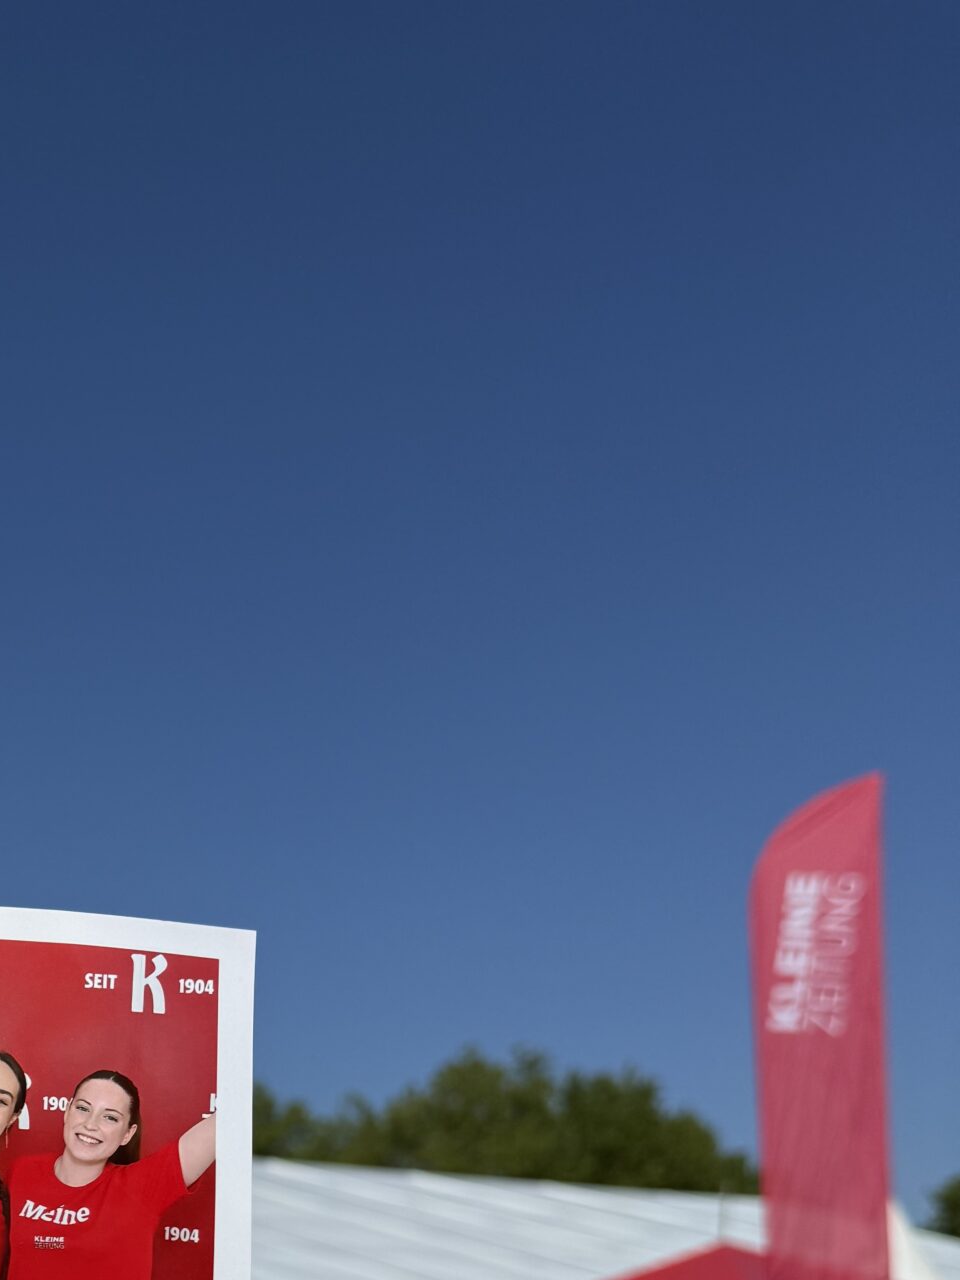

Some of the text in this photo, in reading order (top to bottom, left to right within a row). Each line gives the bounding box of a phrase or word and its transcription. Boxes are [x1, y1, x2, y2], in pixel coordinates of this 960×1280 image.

[766, 872, 820, 1033] KLEINE
[84, 953, 215, 1014] SEIT K 1904
[43, 1096, 73, 1112] 190
[19, 1199, 90, 1226] Meine
[34, 1235, 65, 1243] KLEINE
[164, 1226, 200, 1243] 1904
